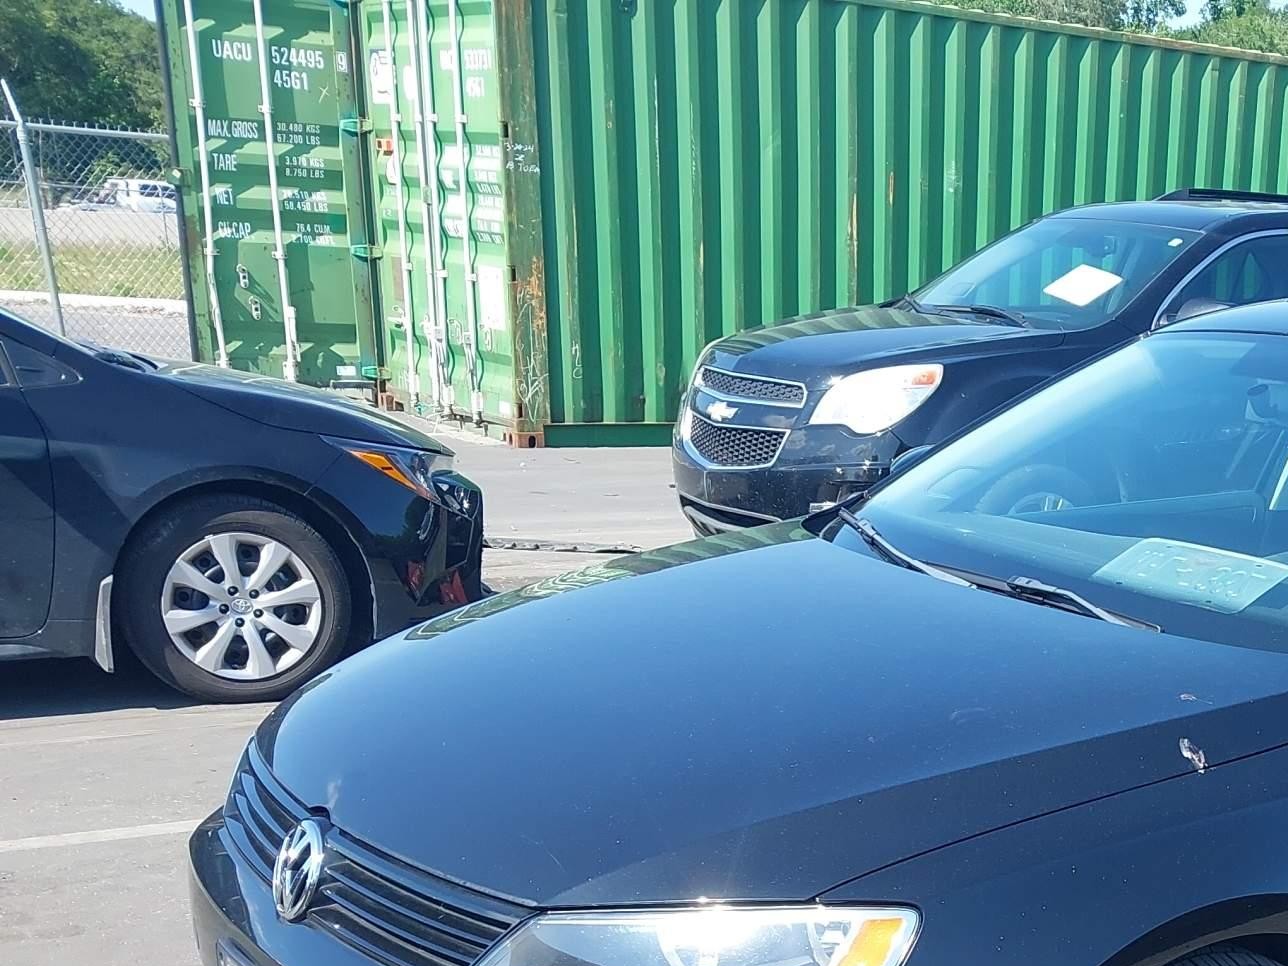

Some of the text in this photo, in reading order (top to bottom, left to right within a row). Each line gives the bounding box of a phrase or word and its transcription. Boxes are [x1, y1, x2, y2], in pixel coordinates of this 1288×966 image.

[211, 39, 252, 61] UACU
[271, 46, 325, 69] 524495
[305, 135, 321, 145] LBS
[212, 153, 237, 172] TARE
[310, 169, 325, 179] LBS
[215, 187, 234, 206] NET
